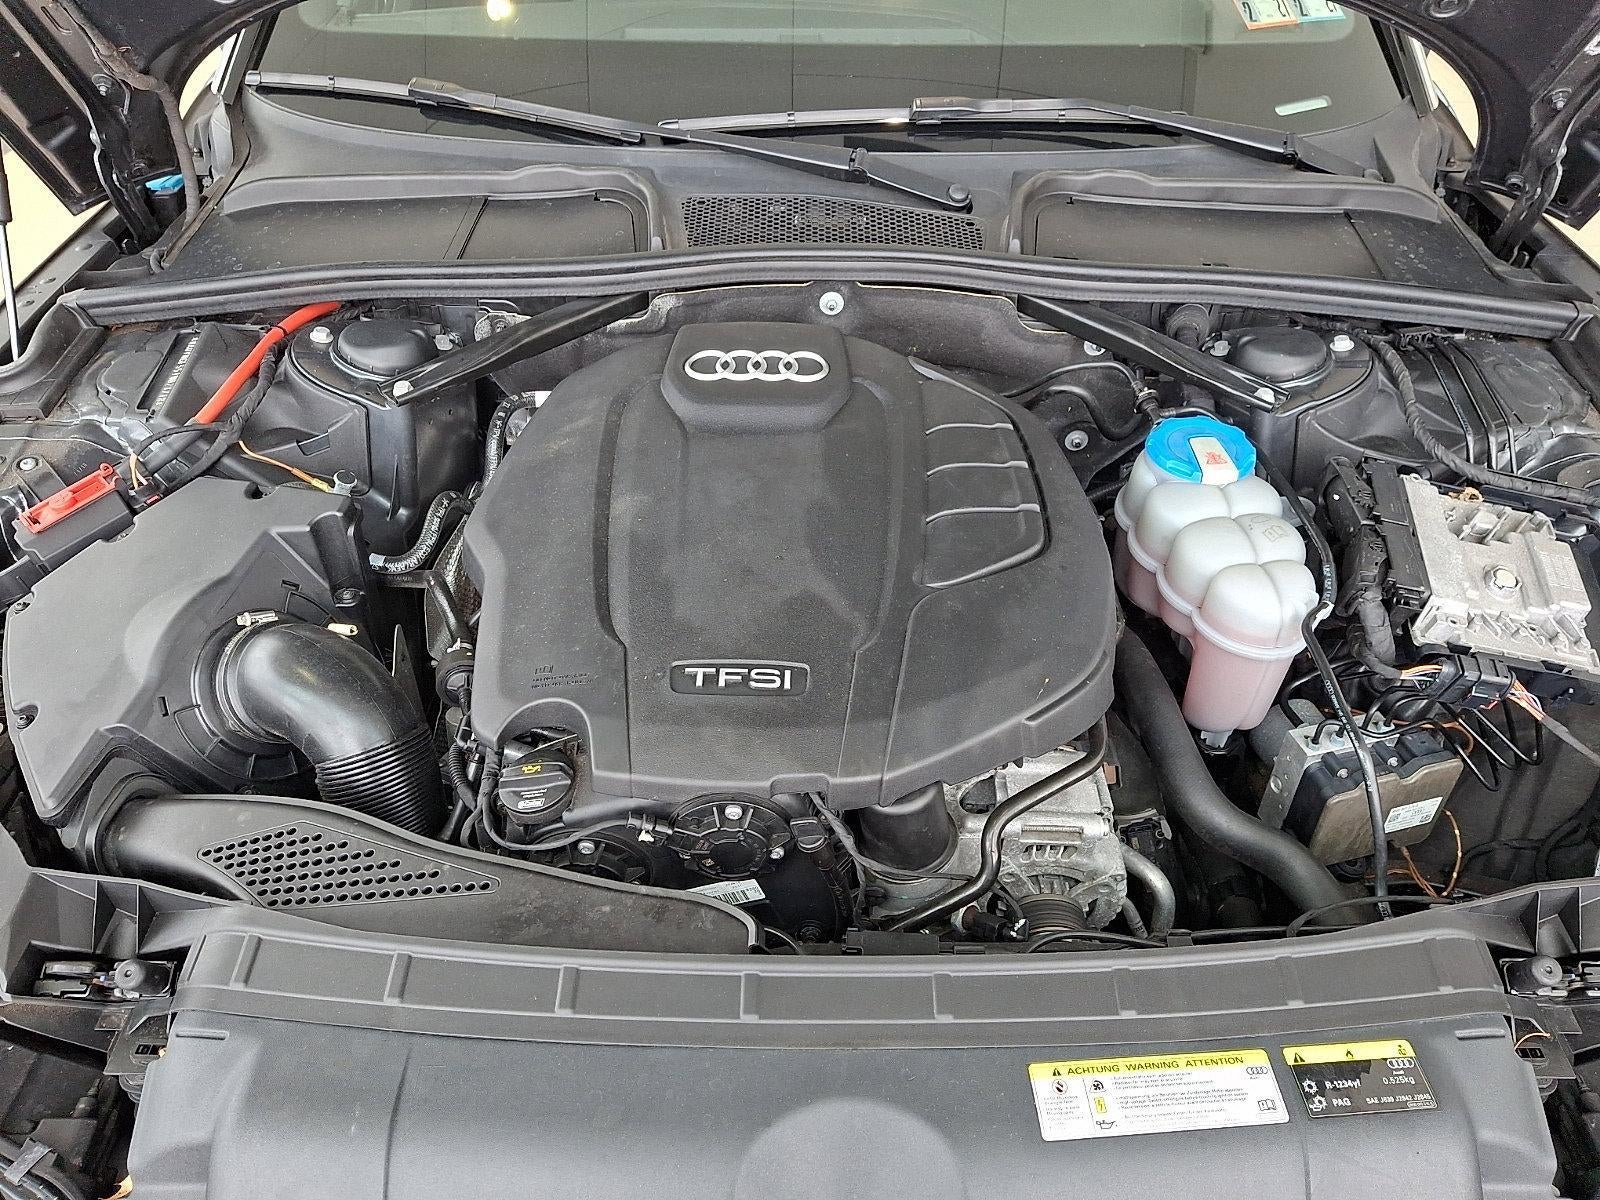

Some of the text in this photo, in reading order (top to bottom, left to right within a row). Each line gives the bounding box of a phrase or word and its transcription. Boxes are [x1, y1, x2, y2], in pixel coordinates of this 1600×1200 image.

[684, 667, 792, 690] TFSI
[1067, 1056, 1244, 1075] ACHTUNG WARNING ATTENTION
[1382, 1075, 1416, 1085] 0.525kg
[1332, 1097, 1352, 1108] PAG
[1365, 1096, 1380, 1105] SAE
